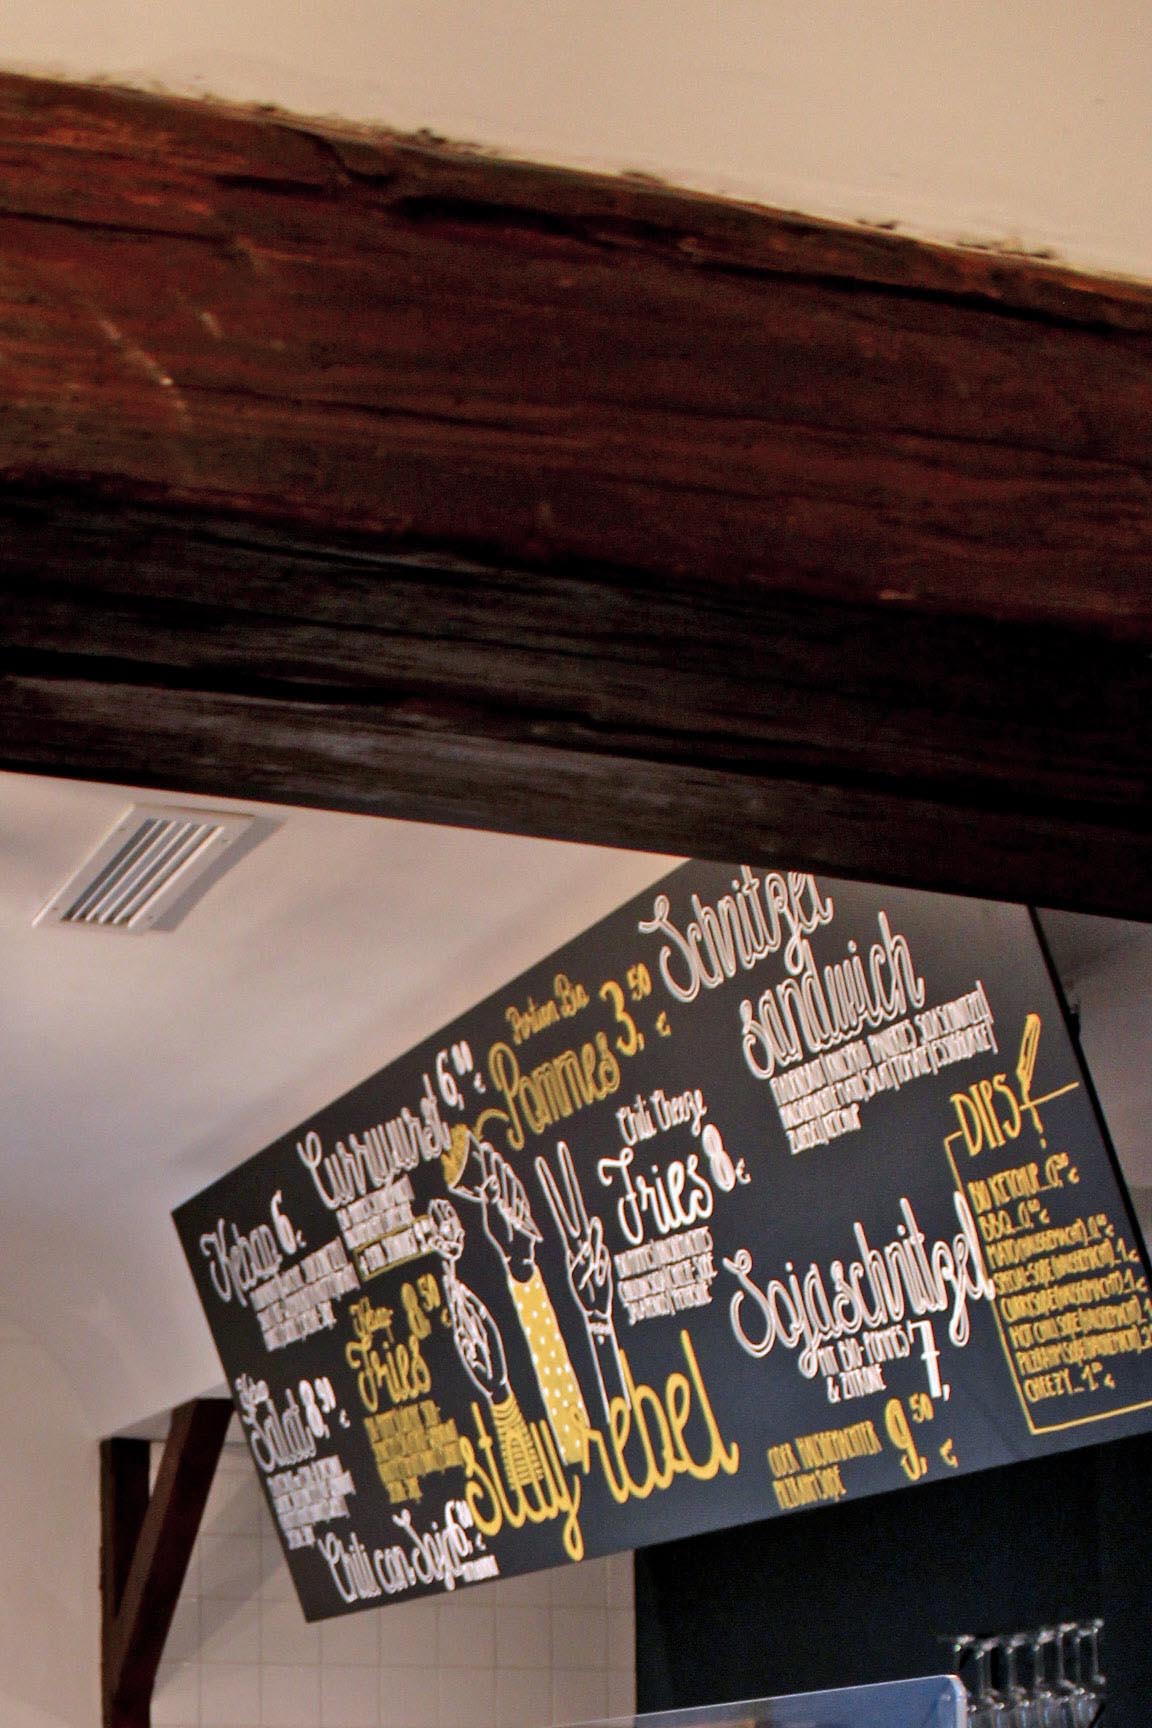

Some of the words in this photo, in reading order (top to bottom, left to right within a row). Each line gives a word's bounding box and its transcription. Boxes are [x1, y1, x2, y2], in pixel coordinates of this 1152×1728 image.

[638, 864, 833, 1003] Schnitzel
[740, 911, 925, 1080] Sandwich
[488, 1031, 621, 1151] Pommes
[949, 1073, 1022, 1158] DIPS
[597, 1148, 713, 1245] Fries
[977, 1208, 1012, 1242] BBQ
[722, 1191, 996, 1379] Sojaschnitzel
[345, 1334, 432, 1413] Fries
[1023, 1368, 1074, 1404] CHEEZY
[459, 1402, 585, 1562] stay
[573, 1329, 740, 1504] rebel
